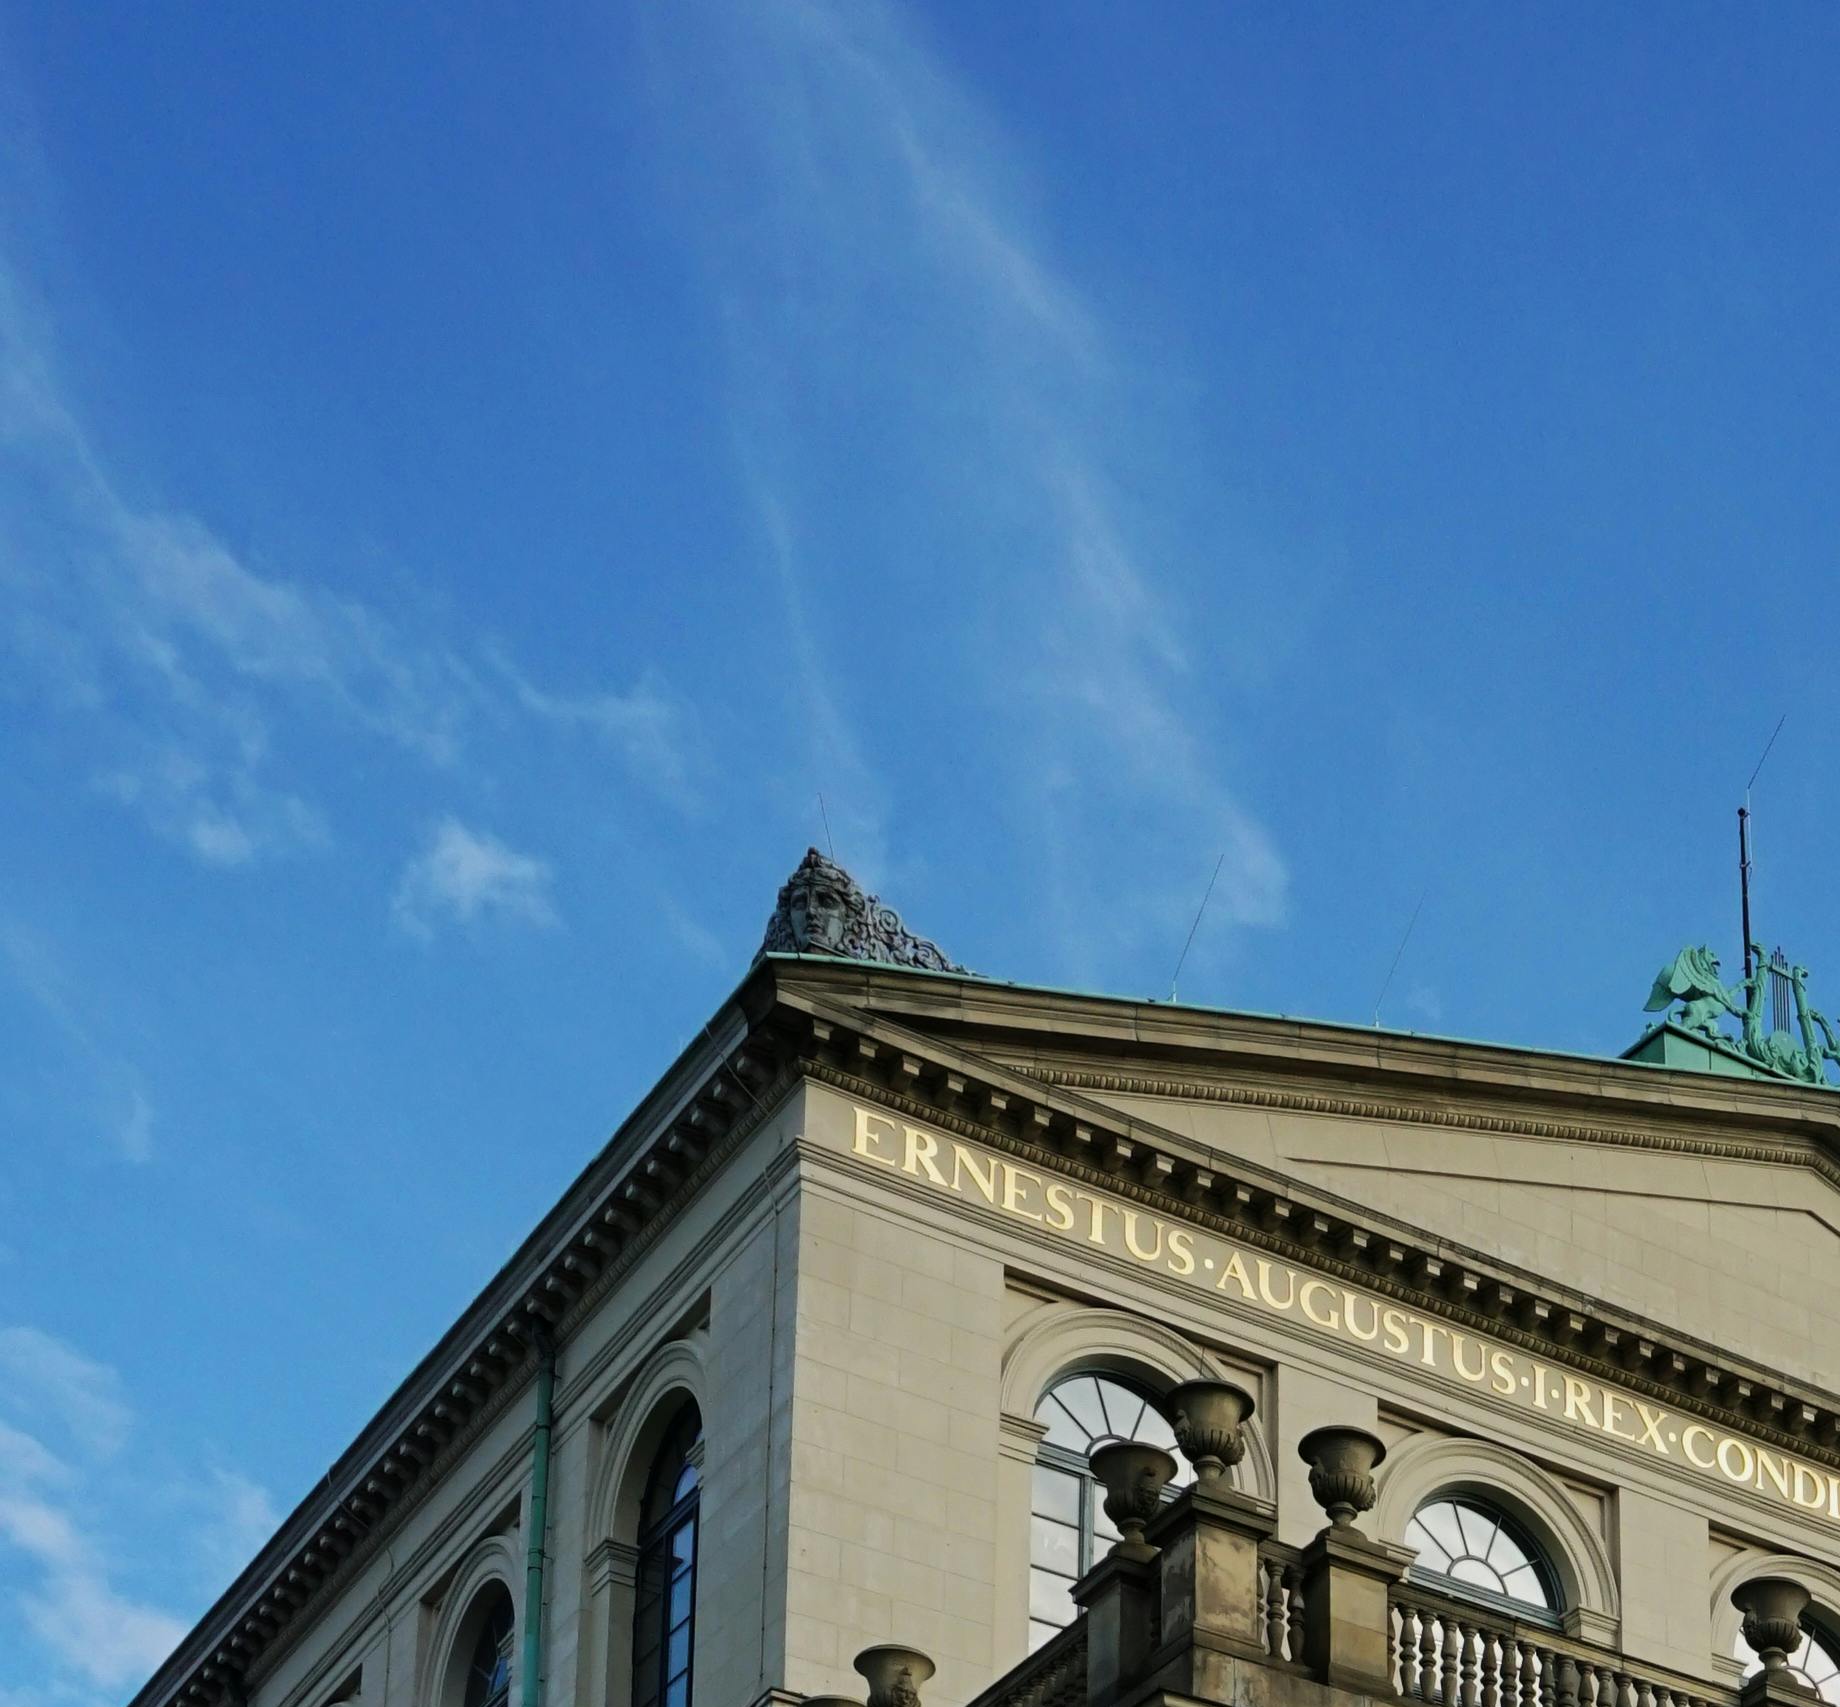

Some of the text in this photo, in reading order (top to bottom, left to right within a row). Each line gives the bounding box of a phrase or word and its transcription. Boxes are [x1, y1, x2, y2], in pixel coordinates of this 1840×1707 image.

[851, 1106, 1196, 1276] ERNESTUS
[1216, 1249, 1518, 1396] AUGUSTUS
[1562, 1373, 1670, 1455] REX
